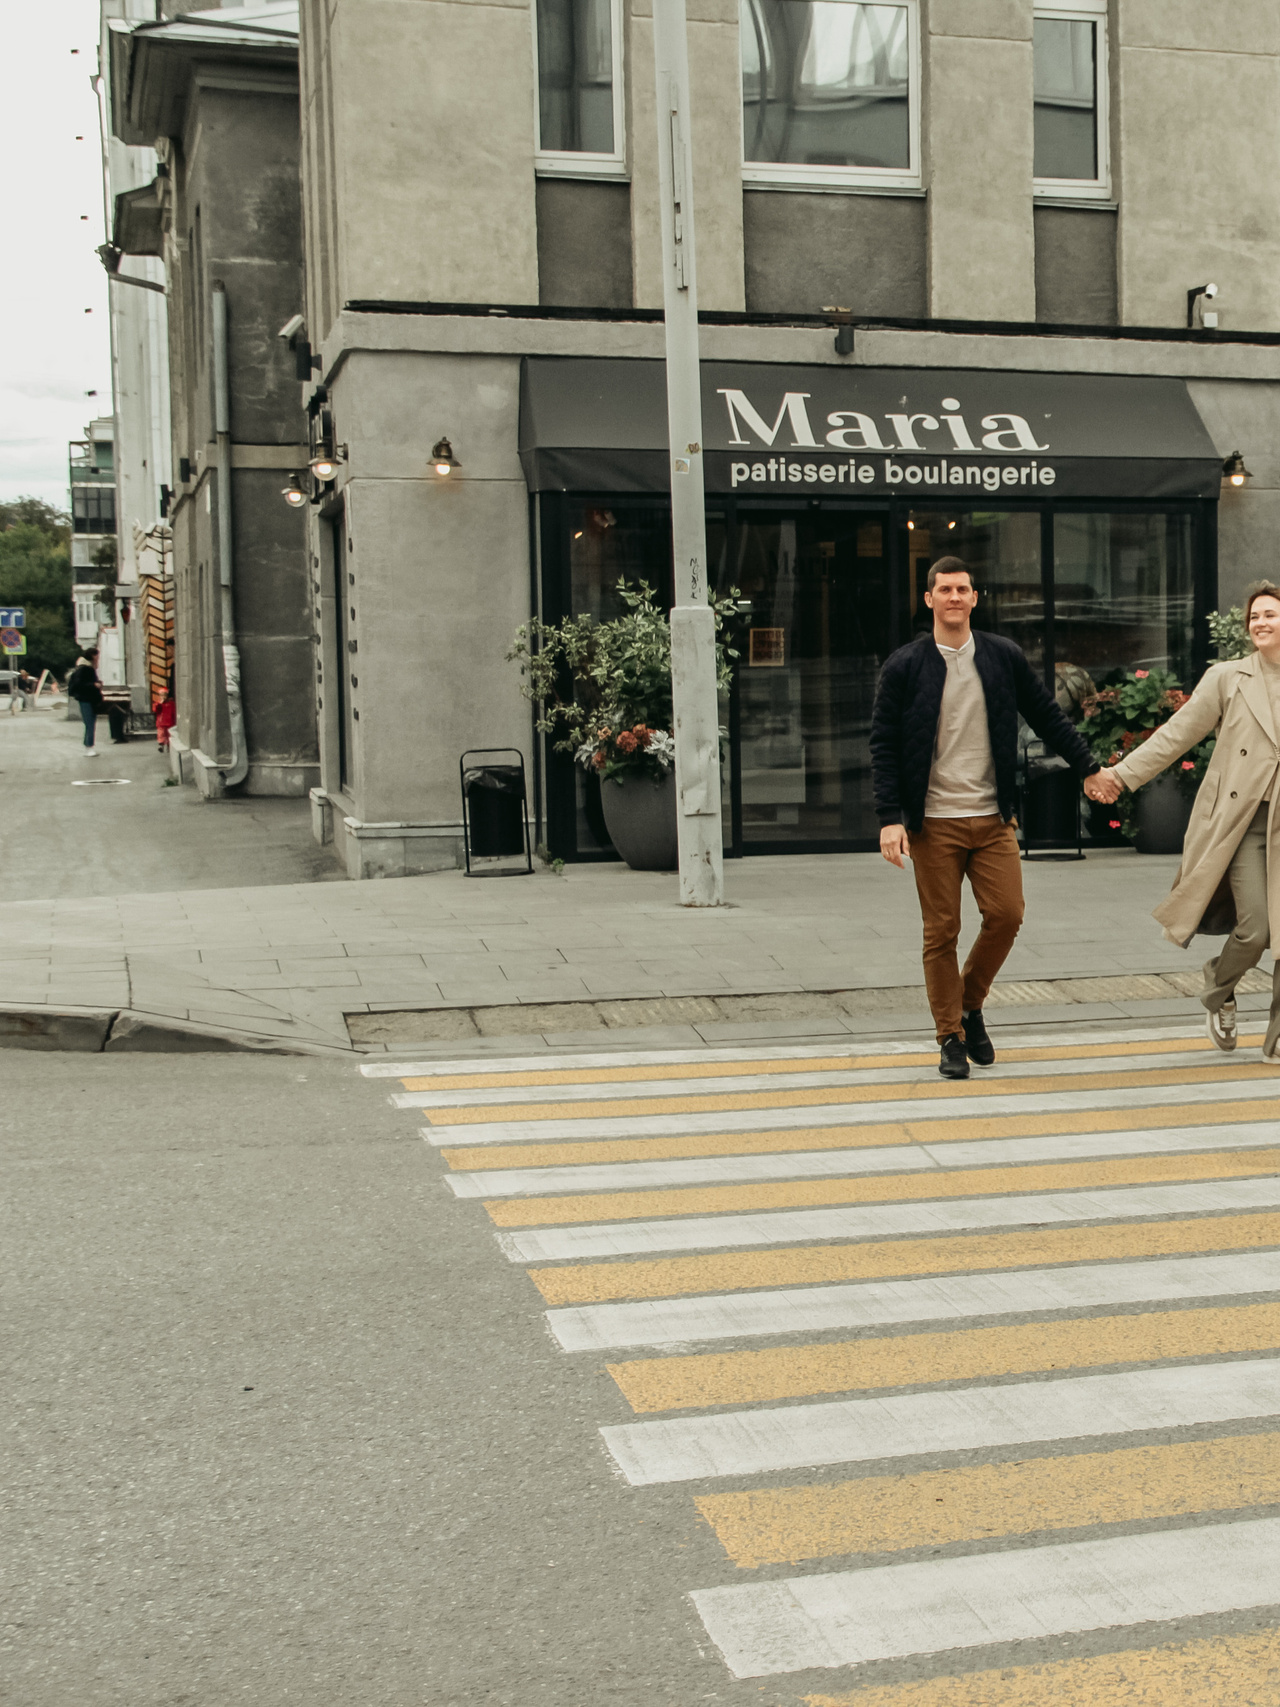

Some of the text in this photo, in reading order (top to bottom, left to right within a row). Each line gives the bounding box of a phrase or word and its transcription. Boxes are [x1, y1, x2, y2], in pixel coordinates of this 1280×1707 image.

[716, 388, 1050, 452] Maria
[731, 457, 1056, 491] patisserie boulangerie
